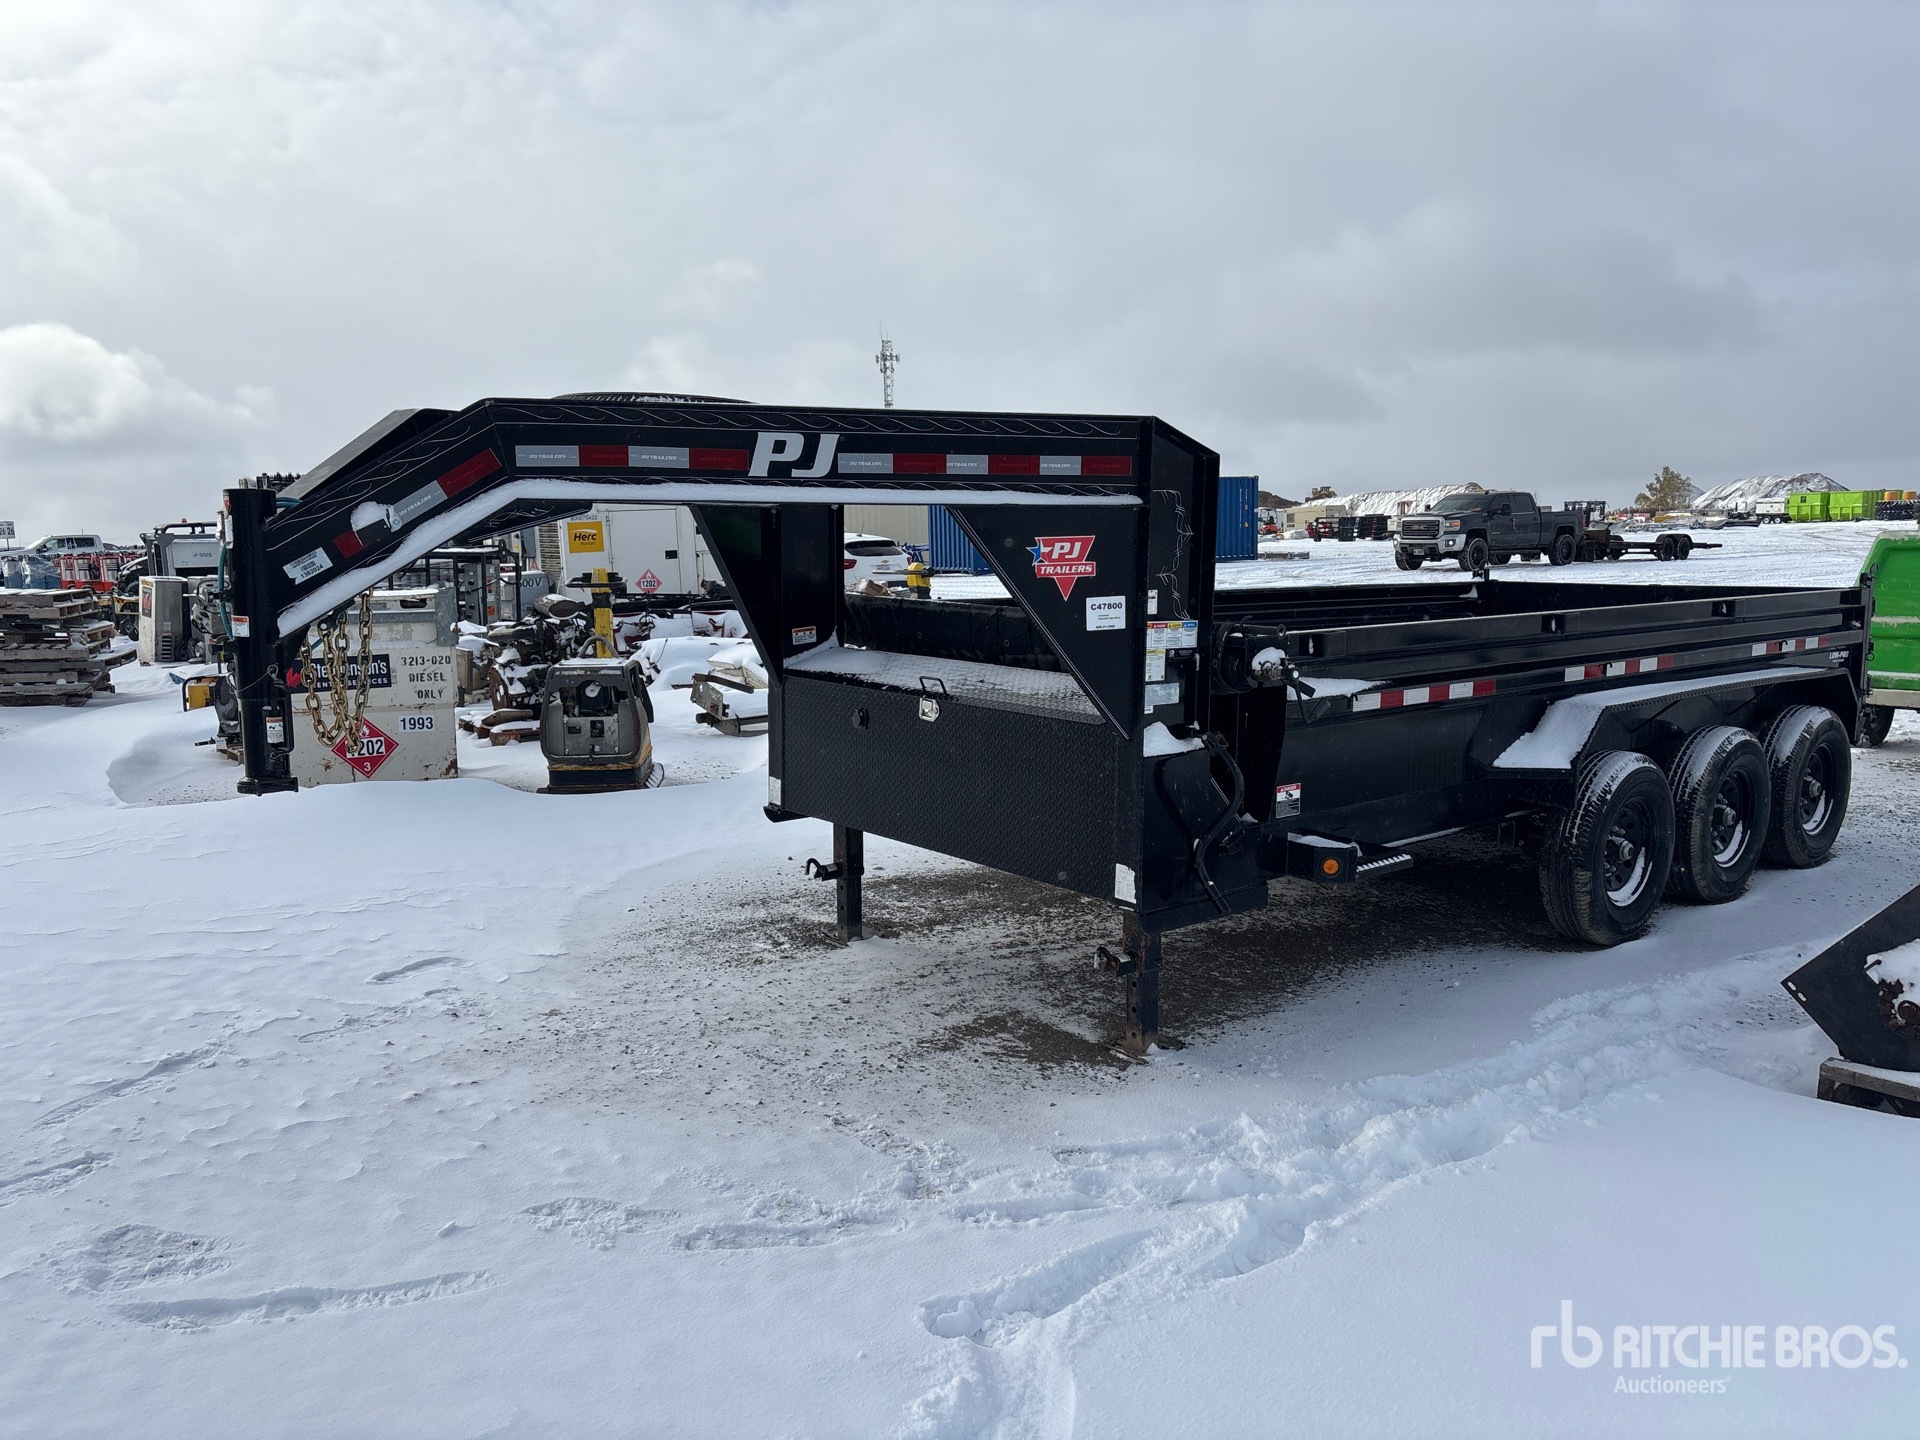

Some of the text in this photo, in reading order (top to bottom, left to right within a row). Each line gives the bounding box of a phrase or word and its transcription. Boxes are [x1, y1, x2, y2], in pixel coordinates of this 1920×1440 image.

[748, 432, 840, 478] PJ
[574, 532, 598, 542] Herc
[1052, 542, 1082, 559] PJ
[1040, 564, 1092, 574] TRAILERS
[642, 580, 656, 588] 1202
[1090, 602, 1122, 610] C47800
[400, 656, 451, 666] 3213-020
[310, 660, 388, 679] Stensn's
[347, 678, 388, 686] SECES
[408, 672, 448, 682] DIESEL
[417, 688, 444, 699] ONLY
[400, 717, 434, 730] 1993
[352, 739, 384, 756] 202
[364, 762, 371, 772] 3
